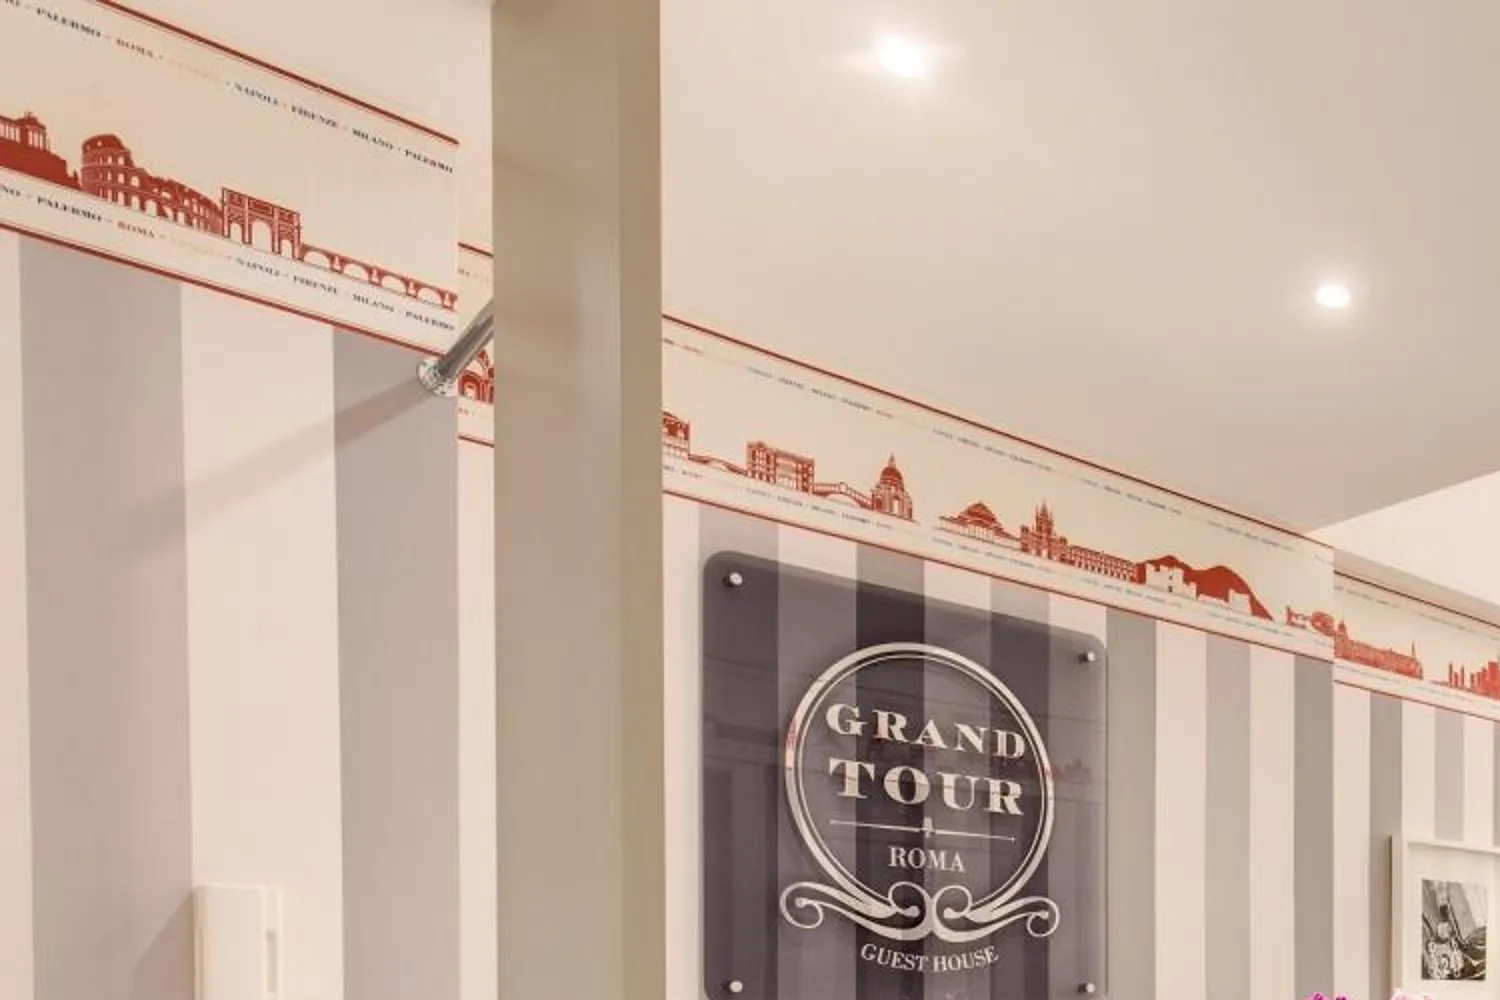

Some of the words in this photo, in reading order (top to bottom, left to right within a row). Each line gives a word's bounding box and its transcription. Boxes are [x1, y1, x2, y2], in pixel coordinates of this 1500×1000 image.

[826, 703, 1026, 759] GRAND
[829, 757, 1025, 816] TOUR
[888, 846, 965, 873] ROMA
[860, 943, 929, 972] GUEST
[933, 945, 999, 973] HOUSE
